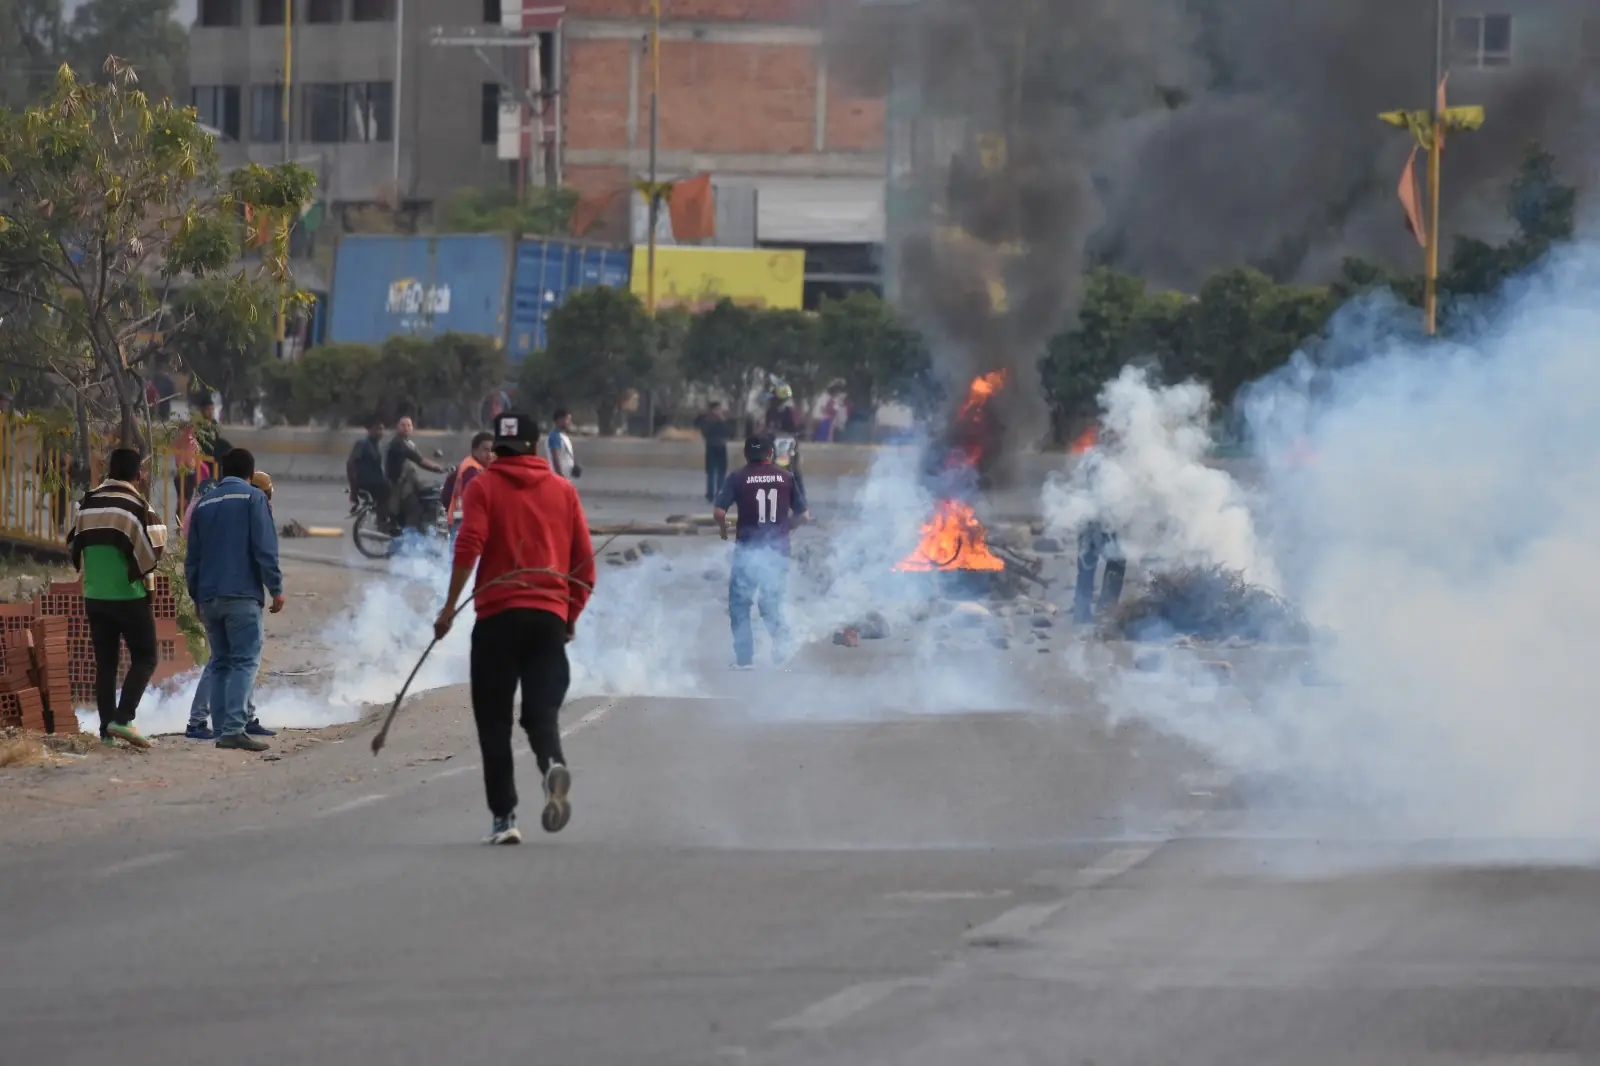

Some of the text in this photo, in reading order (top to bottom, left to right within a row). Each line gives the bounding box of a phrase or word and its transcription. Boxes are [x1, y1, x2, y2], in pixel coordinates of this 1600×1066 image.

[746, 474, 784, 484] JACKSON M.
[756, 488, 777, 523] 11
